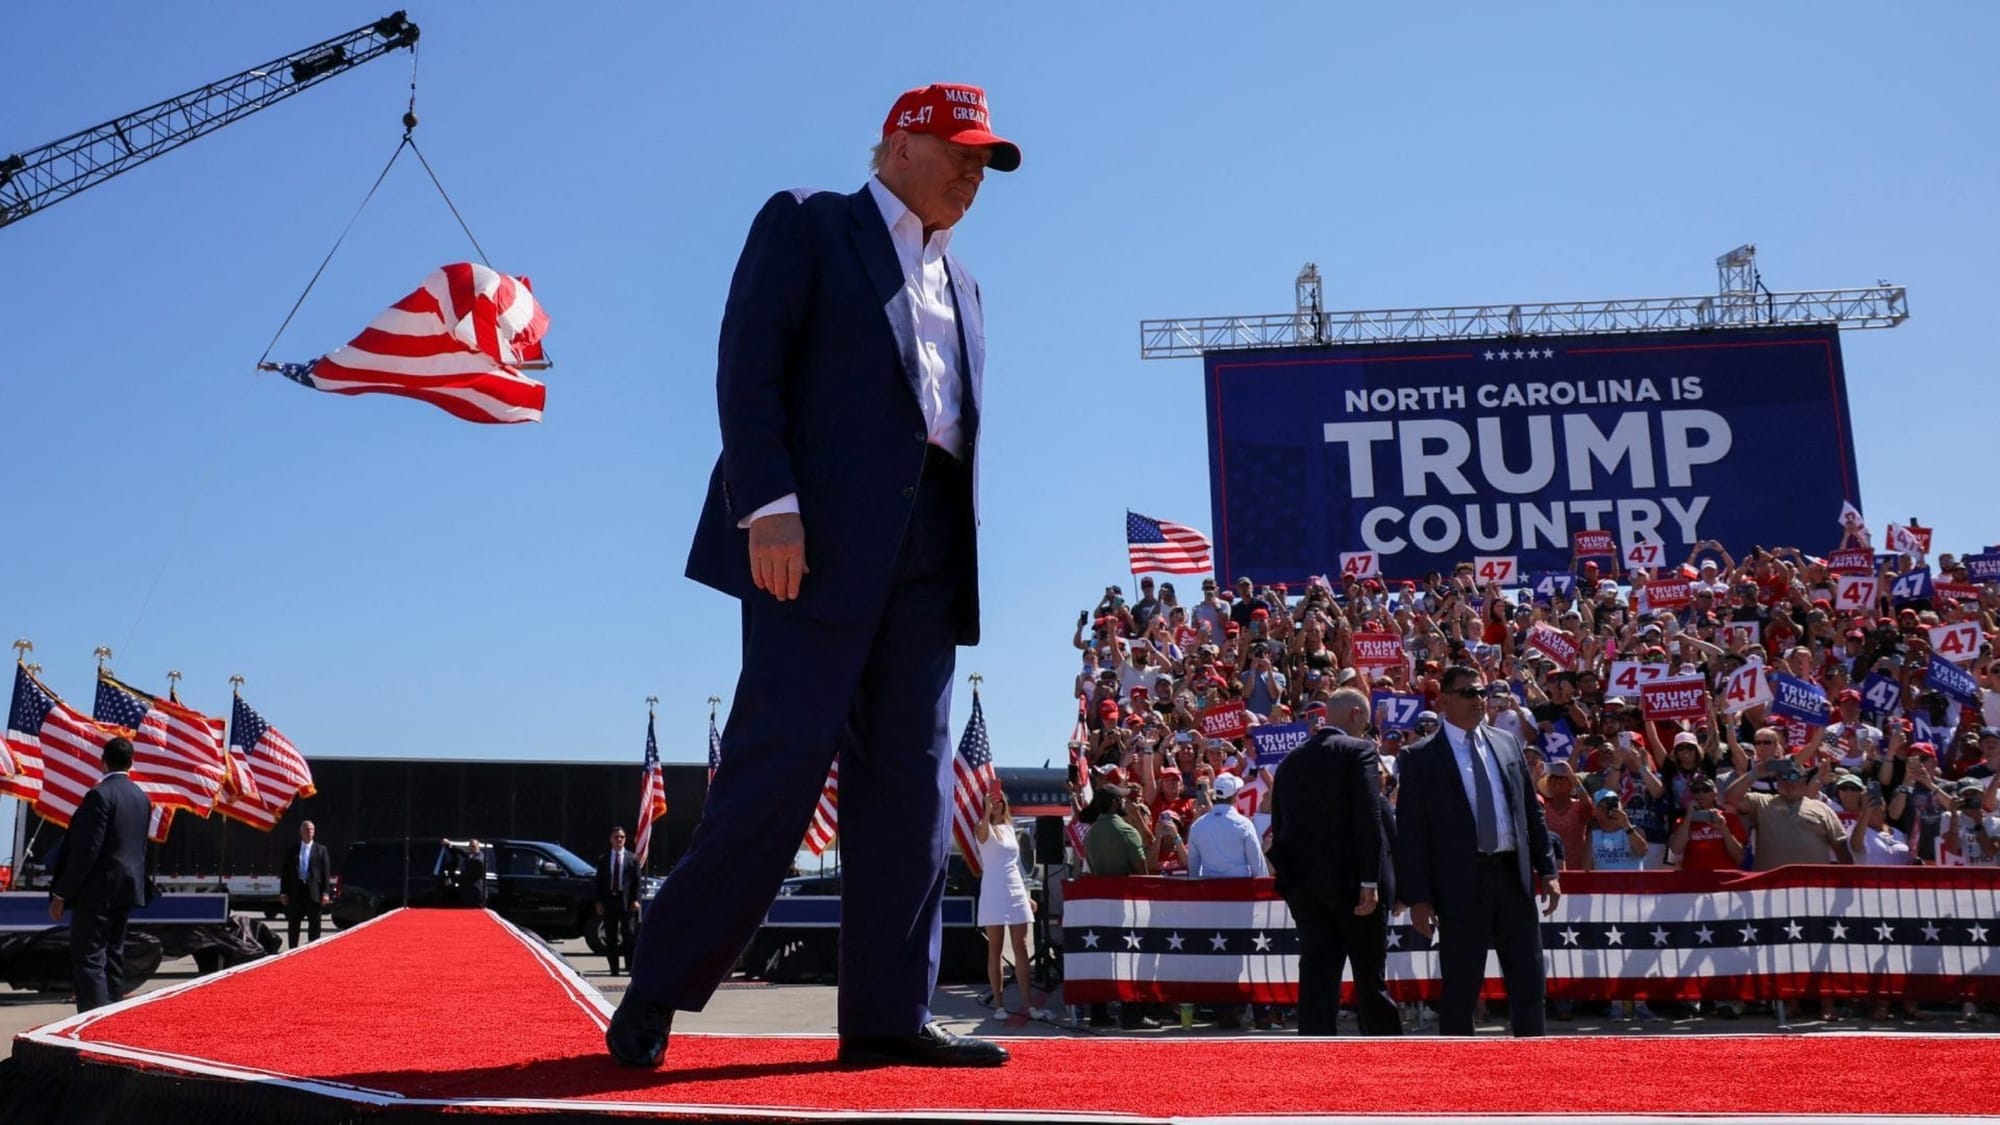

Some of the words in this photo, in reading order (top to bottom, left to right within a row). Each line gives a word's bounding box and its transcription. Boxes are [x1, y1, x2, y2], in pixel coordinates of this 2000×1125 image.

[945, 89, 977, 105] MAKE
[896, 105, 933, 128] 45-47
[1345, 385, 1465, 412] NORTH
[1477, 378, 1660, 408] CAROLINA
[1672, 376, 1703, 400] IS
[1323, 409, 1732, 499] TRUMP
[1360, 497, 1710, 555] COUNTRY
[1628, 545, 1658, 563] 47
[1345, 555, 1372, 575] 47
[1479, 561, 1512, 581] 47
[1536, 576, 1571, 597] 47
[1648, 584, 1688, 595] TRUMP
[1654, 591, 1685, 600] VANCE
[1843, 581, 1875, 604] 47
[1892, 573, 1925, 598] 47
[1355, 641, 1400, 650] TRUMP
[1538, 627, 1575, 655] TRUMP
[1942, 627, 1977, 654] 47
[1615, 667, 1661, 690] 47
[1727, 667, 1758, 702] 47
[1645, 689, 1703, 701] TRUMP
[1652, 699, 1699, 710] VANCE
[1784, 693, 1820, 712] VANCE
[1866, 680, 1900, 711] 47
[1203, 721, 1241, 733] VANCE
[1256, 732, 1307, 744] TRUMP
